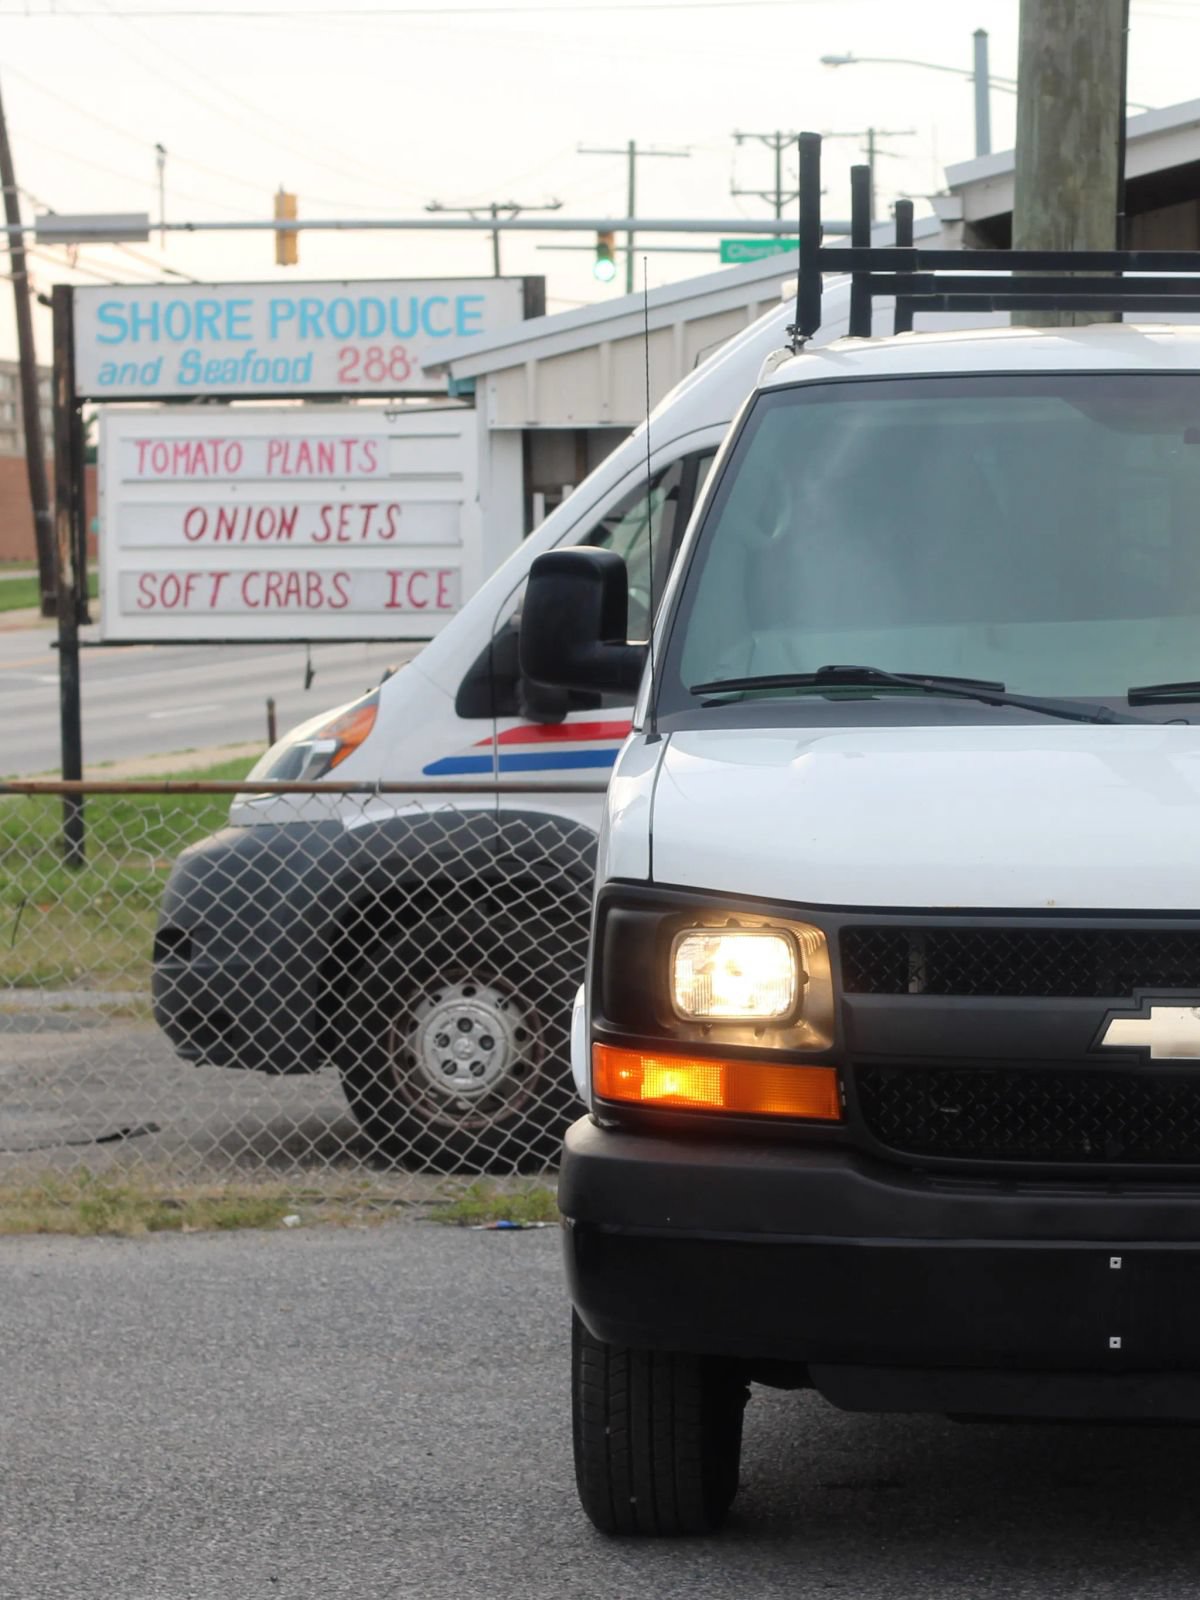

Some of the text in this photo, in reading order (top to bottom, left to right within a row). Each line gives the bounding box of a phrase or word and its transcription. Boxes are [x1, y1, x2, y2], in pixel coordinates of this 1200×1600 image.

[95, 294, 486, 345] SHORE PRODUCE
[98, 356, 161, 386] and
[177, 350, 313, 387] Seafood
[135, 438, 379, 477] TOMATO PLANTS
[183, 503, 402, 542] ONION SETS
[137, 570, 455, 609] SOFT CRABS ICE
